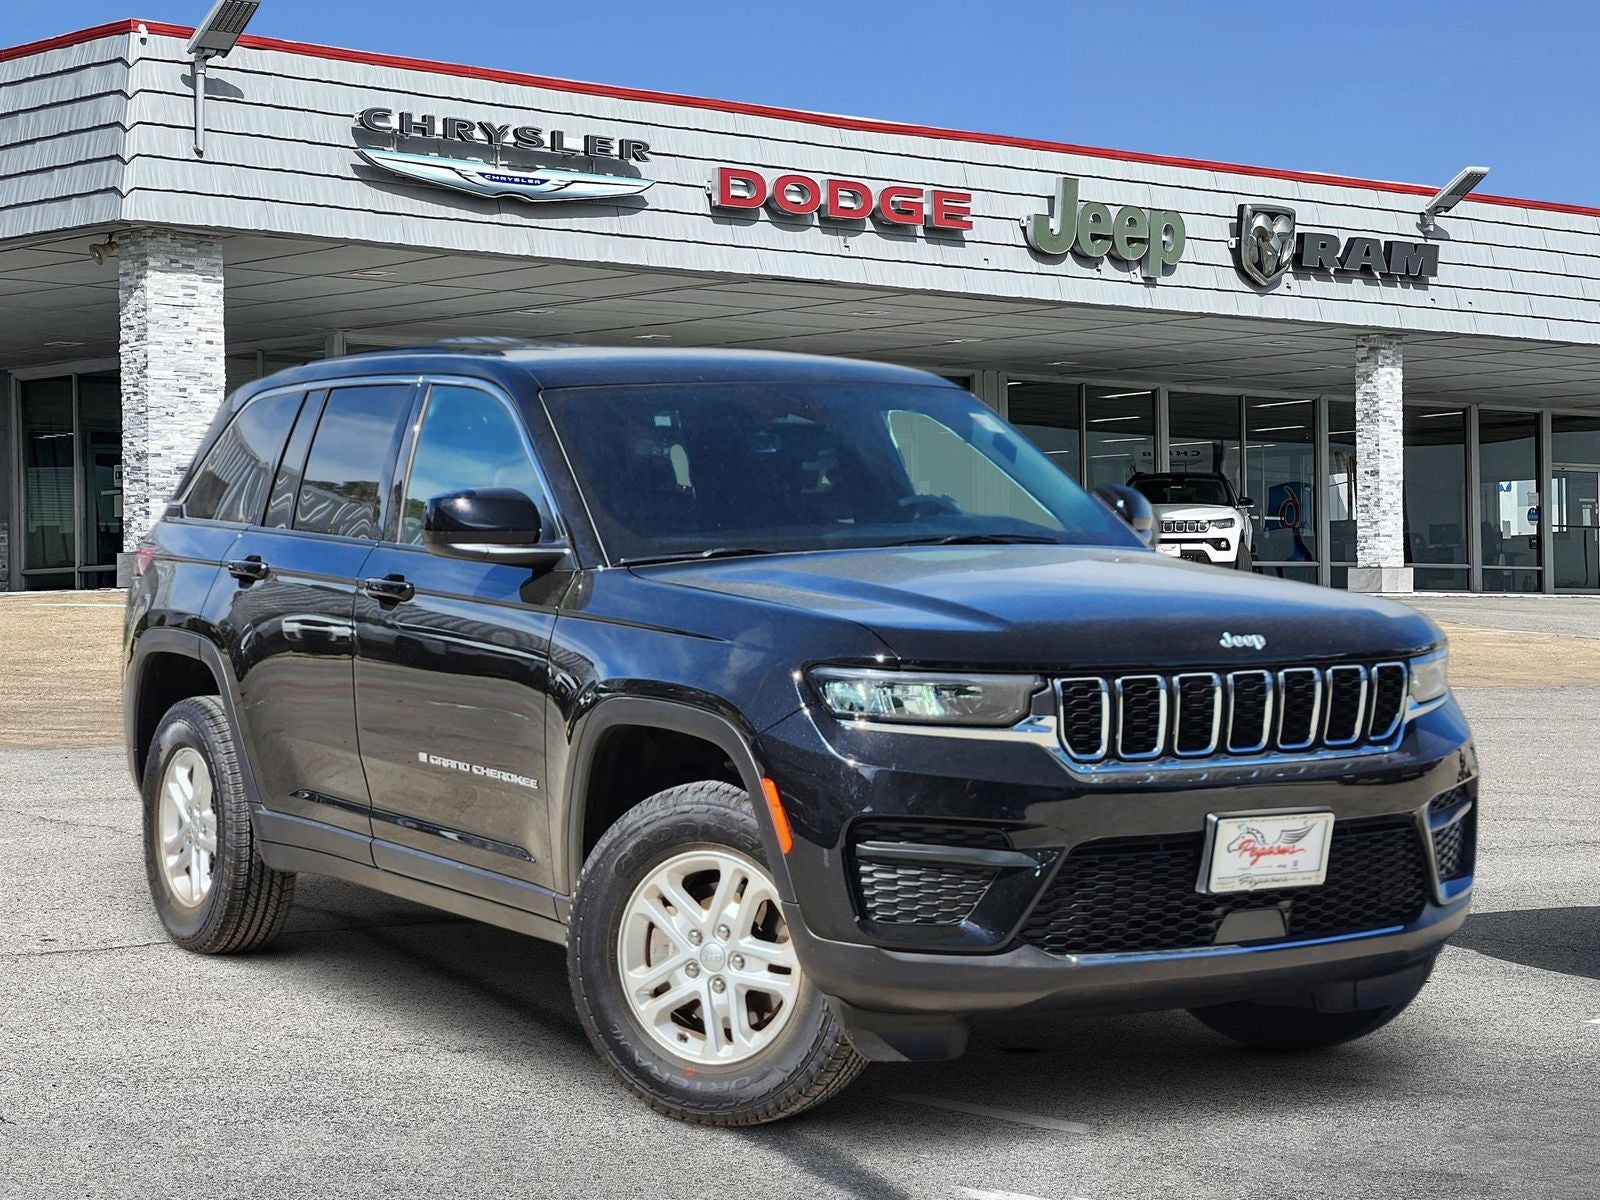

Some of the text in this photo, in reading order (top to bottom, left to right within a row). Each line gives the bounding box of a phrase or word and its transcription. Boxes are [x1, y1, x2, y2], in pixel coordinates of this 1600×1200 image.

[358, 107, 651, 162] CHRYSLER
[484, 174, 541, 185] CHRYSLER
[711, 166, 974, 231] DODGE
[1026, 176, 1187, 279] Jeep
[1296, 232, 1440, 277] RAM
[1219, 631, 1267, 650] Jeep
[428, 754, 539, 789] GRAND CHEROKEE
